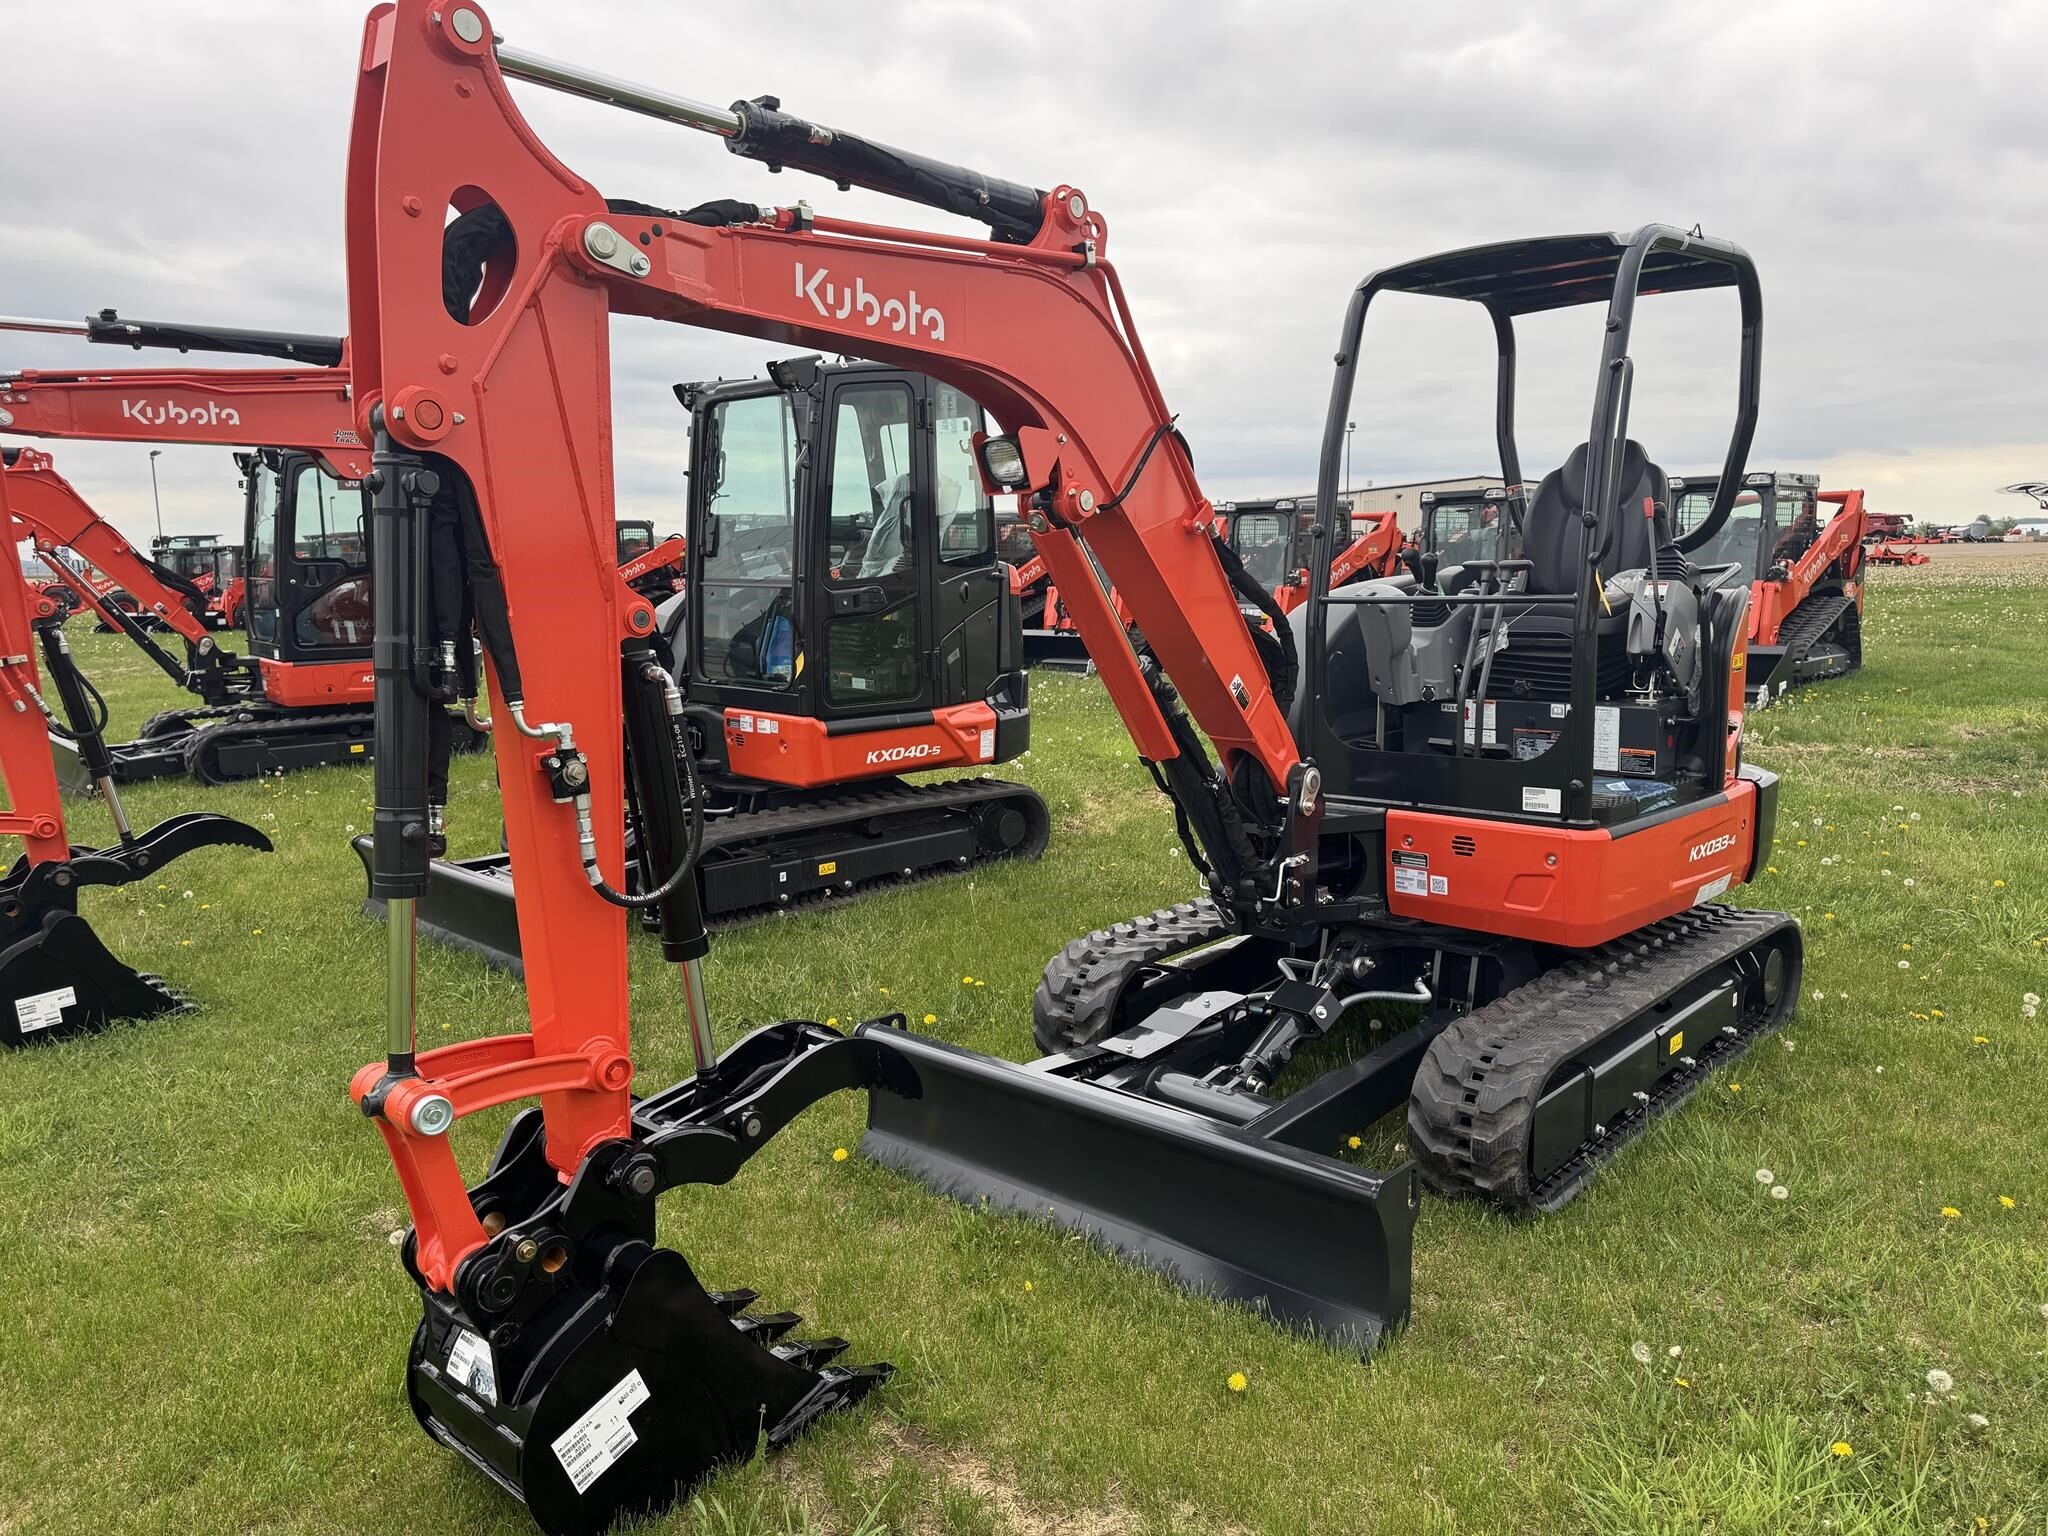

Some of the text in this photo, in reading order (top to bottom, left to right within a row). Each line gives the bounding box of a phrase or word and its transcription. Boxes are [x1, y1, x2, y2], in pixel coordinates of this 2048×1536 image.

[795, 262, 945, 342] Kubota
[122, 399, 240, 425] Kubota
[866, 744, 942, 765] KX040-5
[1688, 833, 1737, 863] KX033-4
